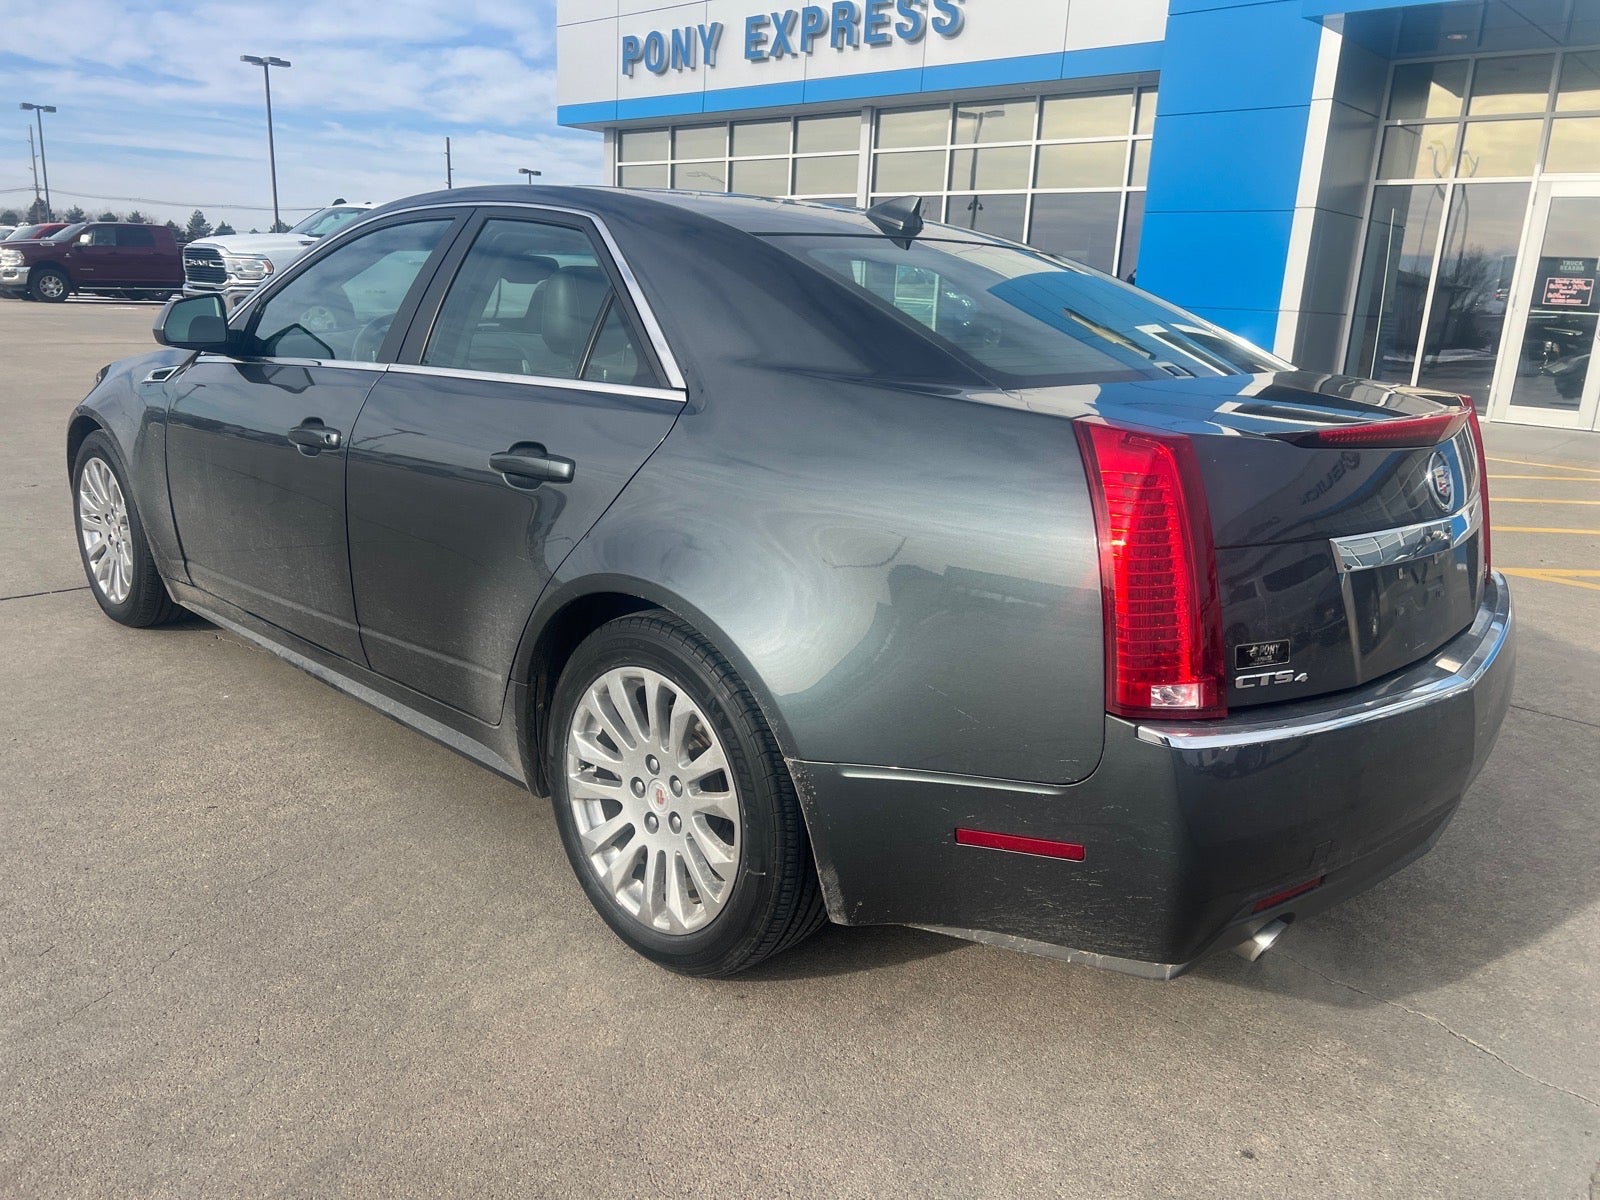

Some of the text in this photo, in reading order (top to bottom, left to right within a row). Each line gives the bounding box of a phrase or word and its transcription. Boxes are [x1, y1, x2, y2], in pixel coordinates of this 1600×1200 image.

[622, 0, 965, 77] PONY EXPRESS
[1259, 643, 1280, 656] PONY
